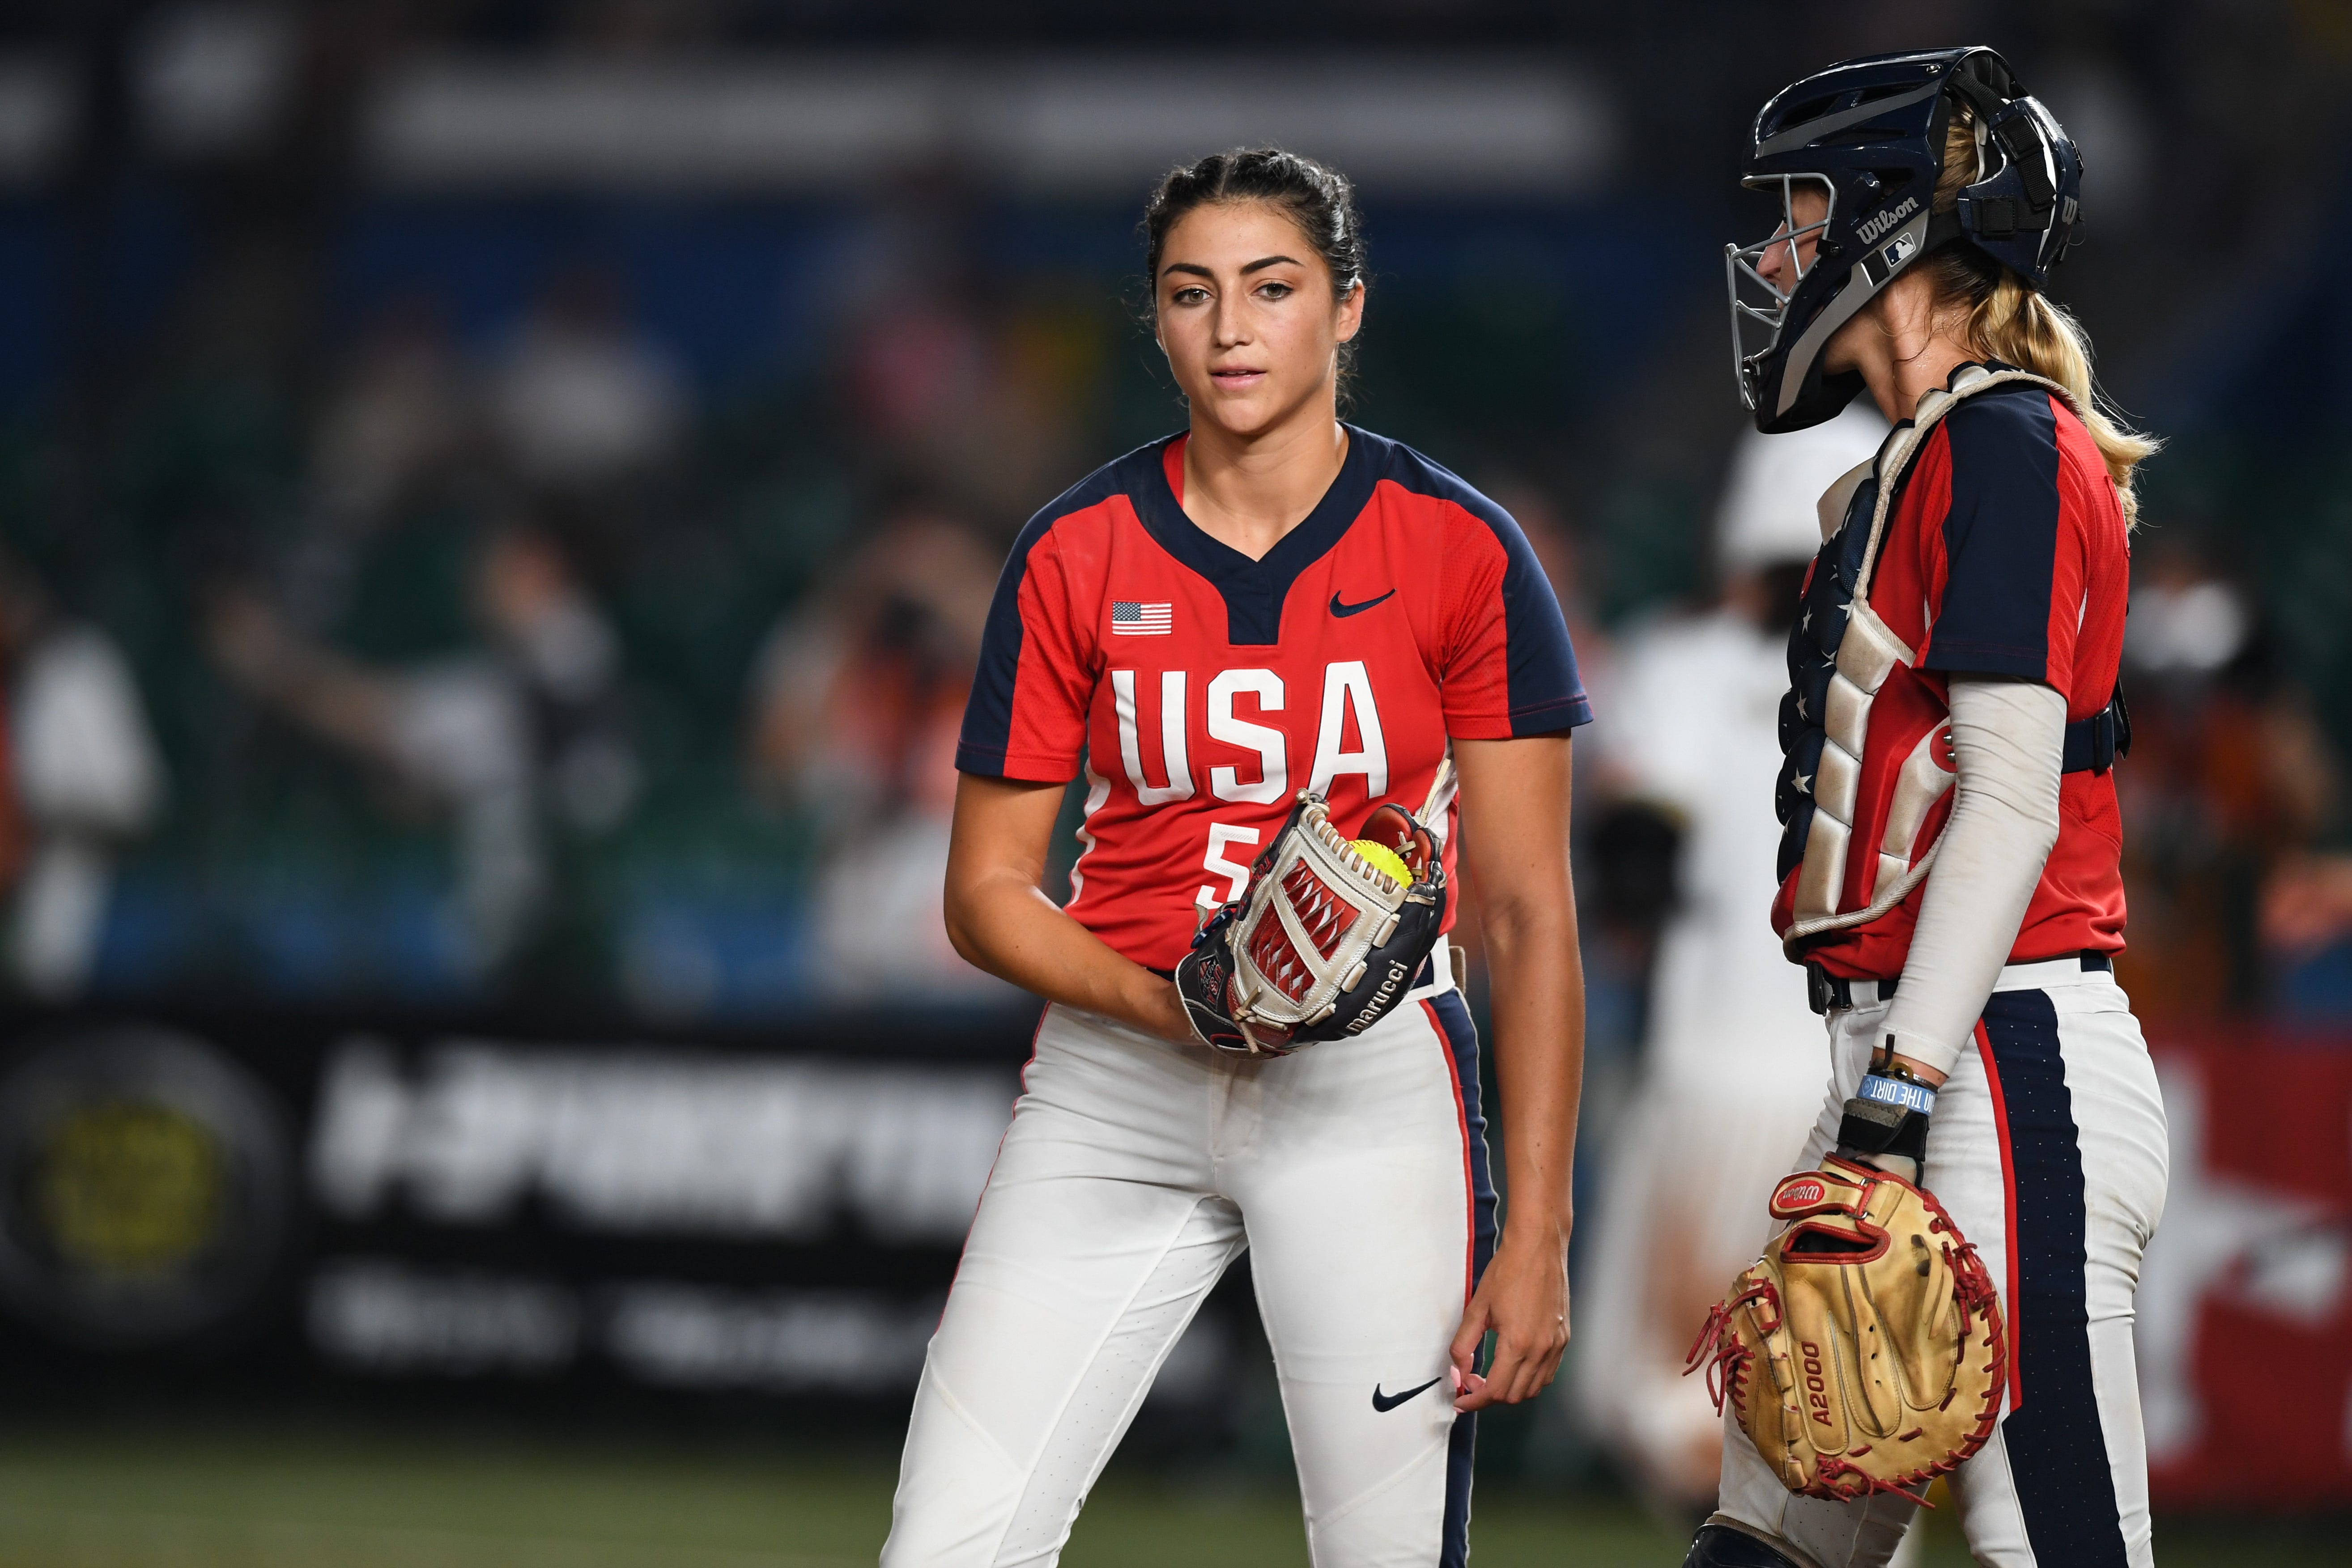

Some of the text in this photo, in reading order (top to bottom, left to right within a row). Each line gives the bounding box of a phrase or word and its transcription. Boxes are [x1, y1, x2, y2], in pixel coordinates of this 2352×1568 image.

[1856, 197, 1919, 244] Wilson
[1111, 660, 1388, 806] USA
[1195, 822, 1260, 910] 5
[1345, 959, 1408, 1033] marucci
[1870, 1079, 1897, 1102] DIRT
[1898, 1086, 1922, 1109] THE
[1783, 1186, 1820, 1201] Wilson
[1801, 1341, 1833, 1427] A2000
